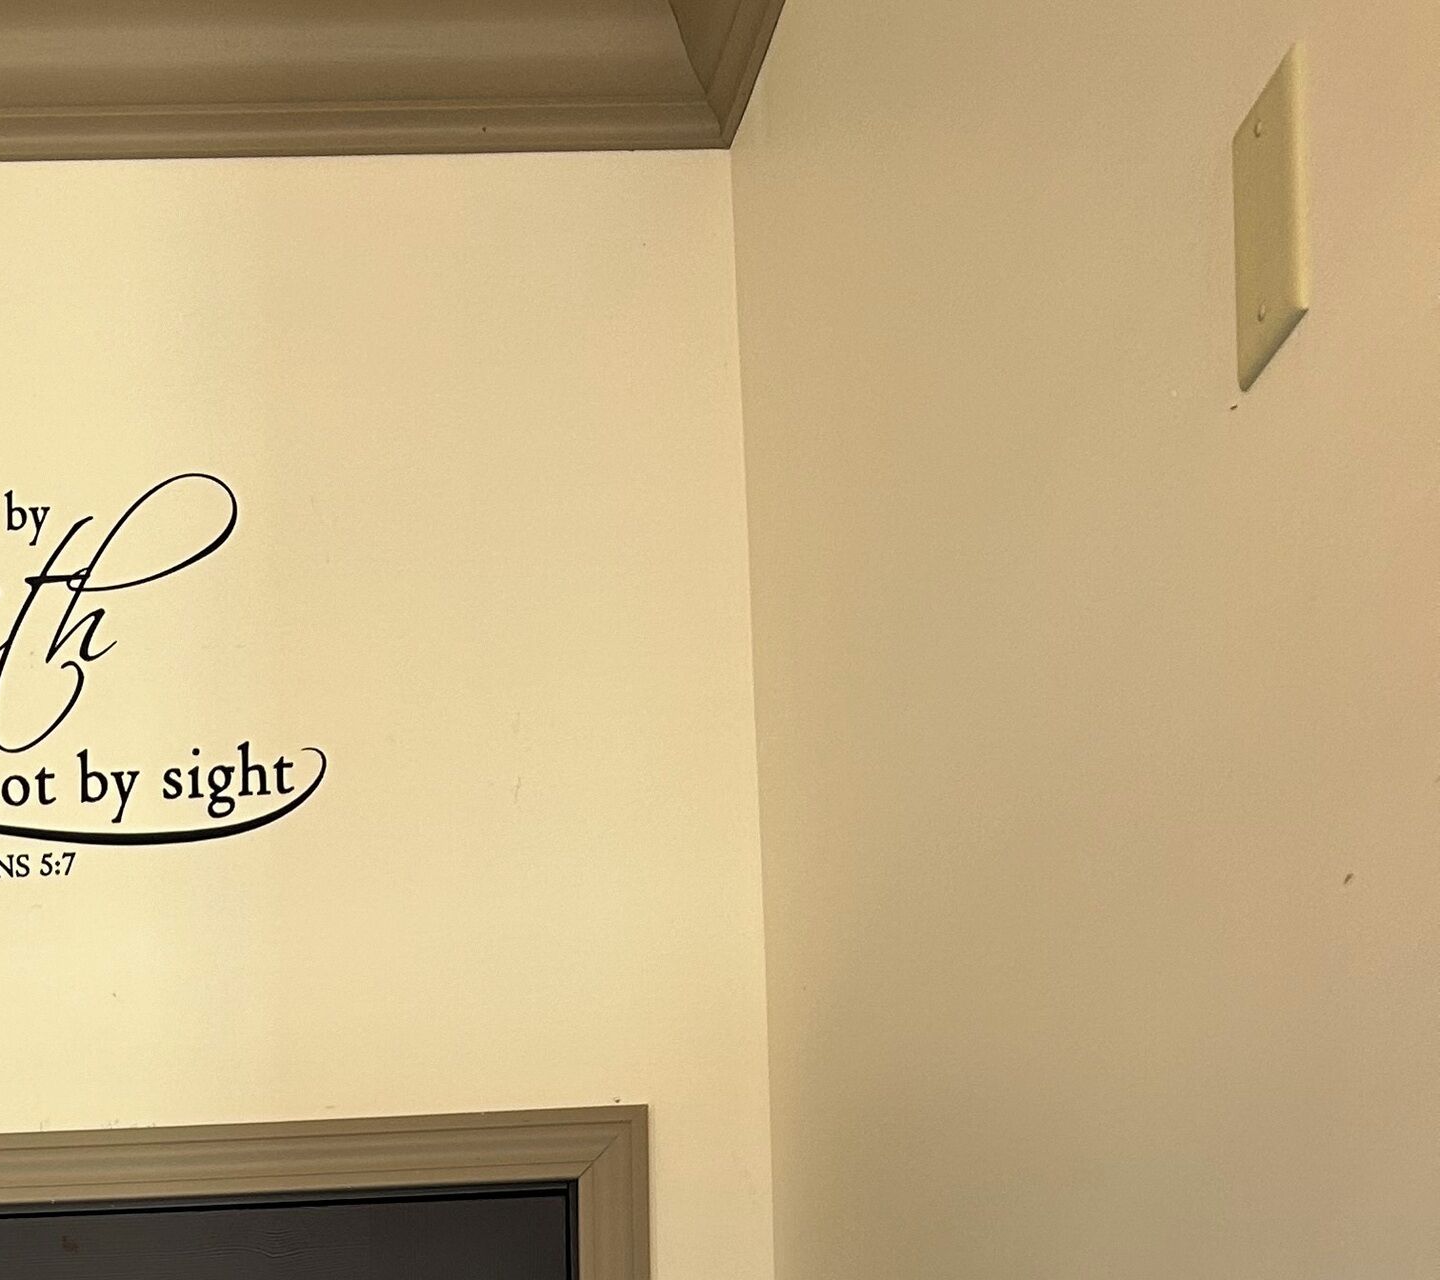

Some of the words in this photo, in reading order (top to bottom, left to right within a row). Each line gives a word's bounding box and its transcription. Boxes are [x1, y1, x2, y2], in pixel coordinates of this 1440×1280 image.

[4, 489, 51, 547] by
[76, 748, 140, 824] by
[162, 740, 295, 819] sight
[39, 852, 76, 877] 5:7
